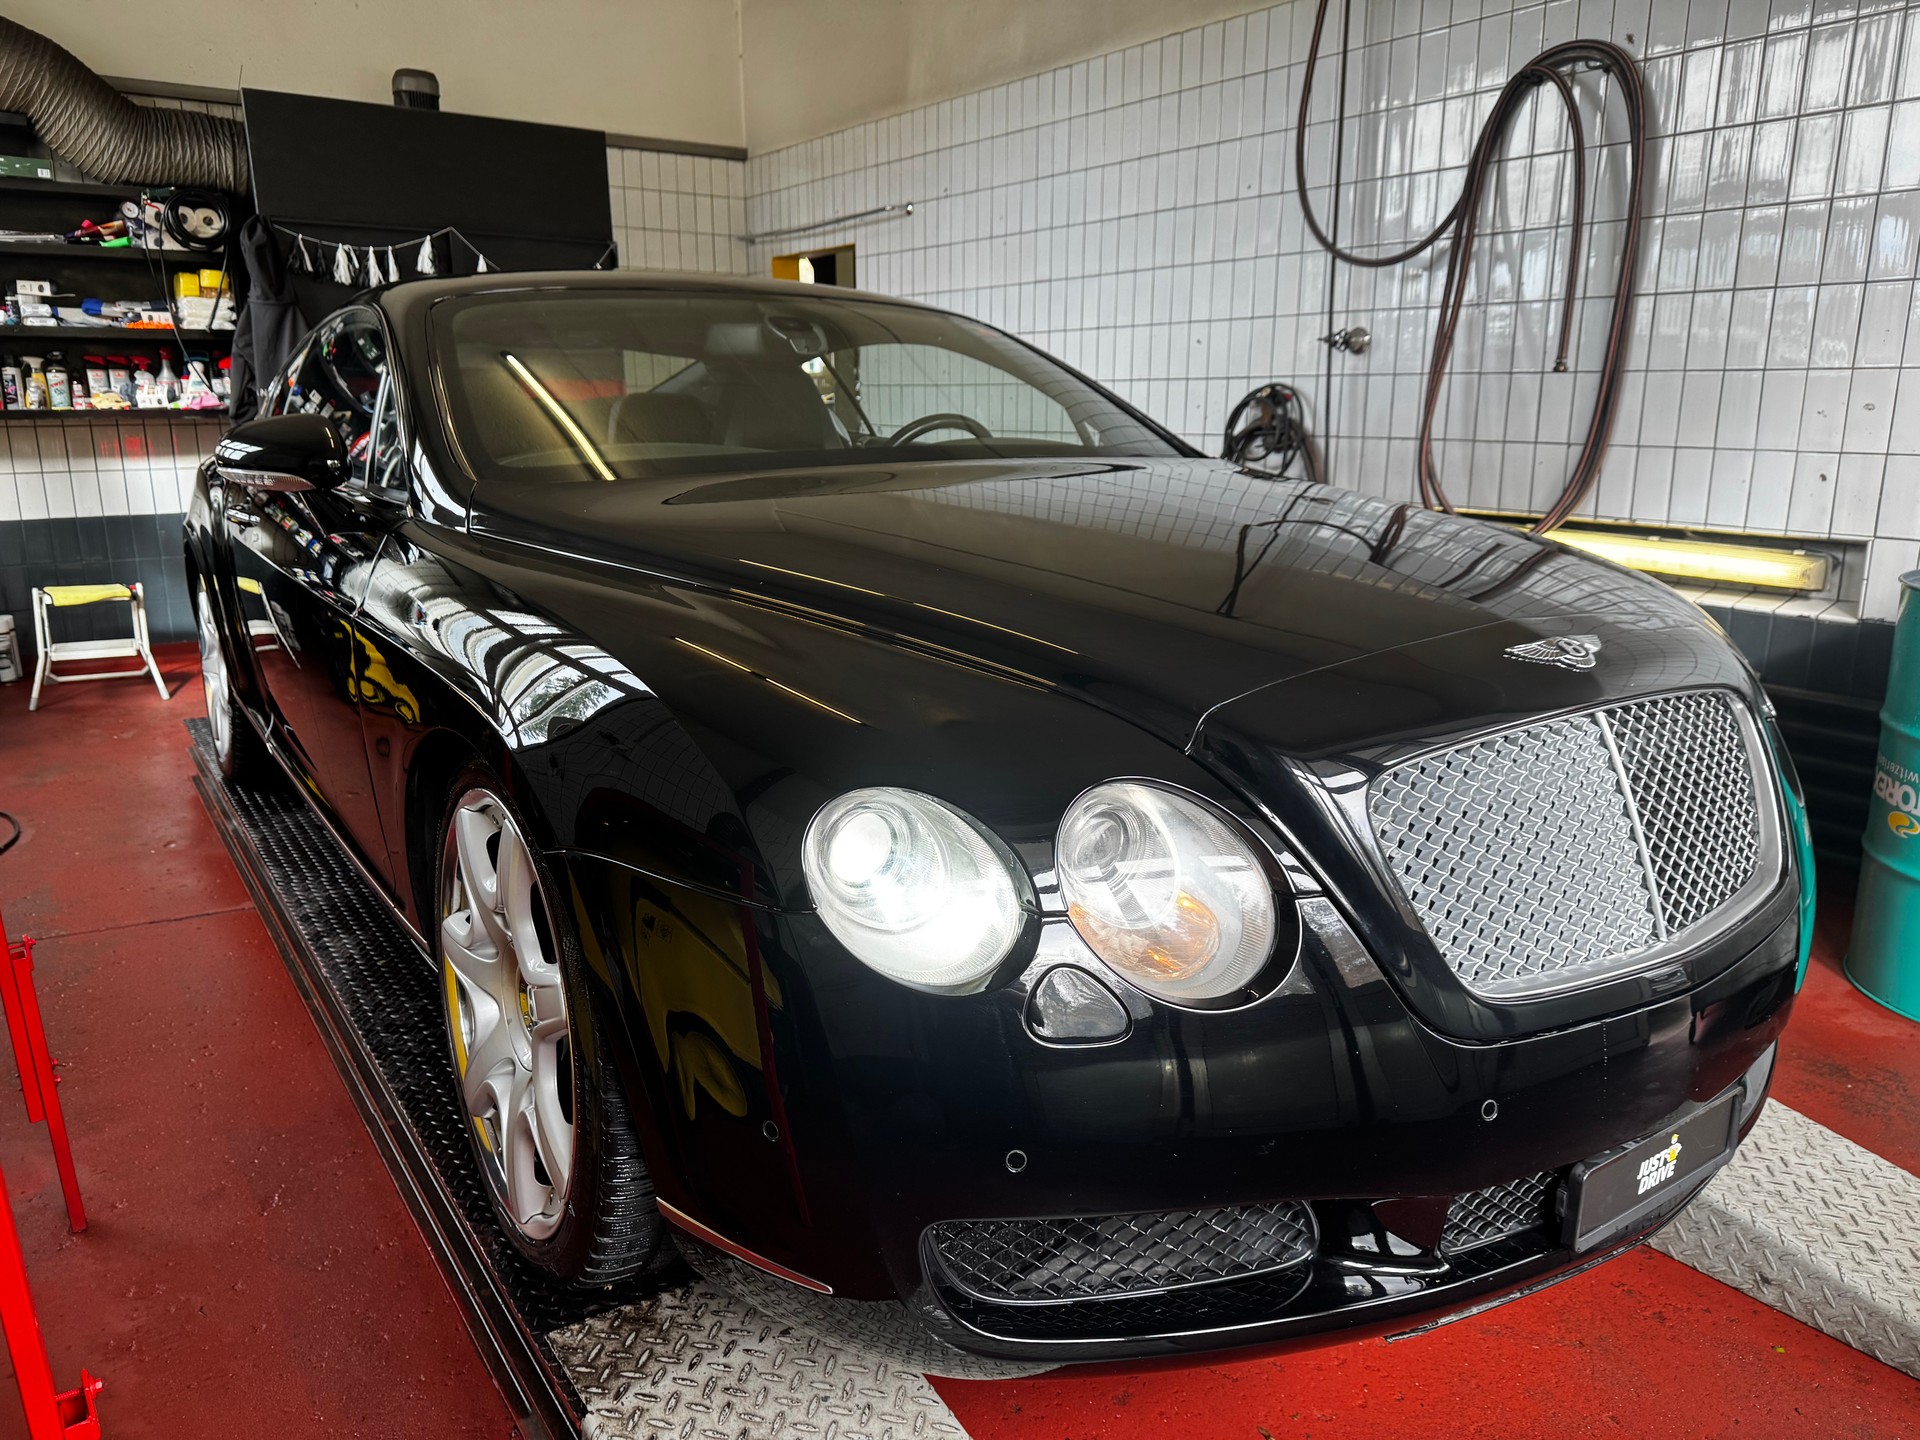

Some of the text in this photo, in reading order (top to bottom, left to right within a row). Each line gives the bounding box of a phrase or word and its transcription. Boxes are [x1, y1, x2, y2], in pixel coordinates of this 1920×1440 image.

[1874, 769, 1920, 817] TORE
[1637, 1149, 1668, 1180] JUST
[1638, 1160, 1677, 1195] DRIVE
